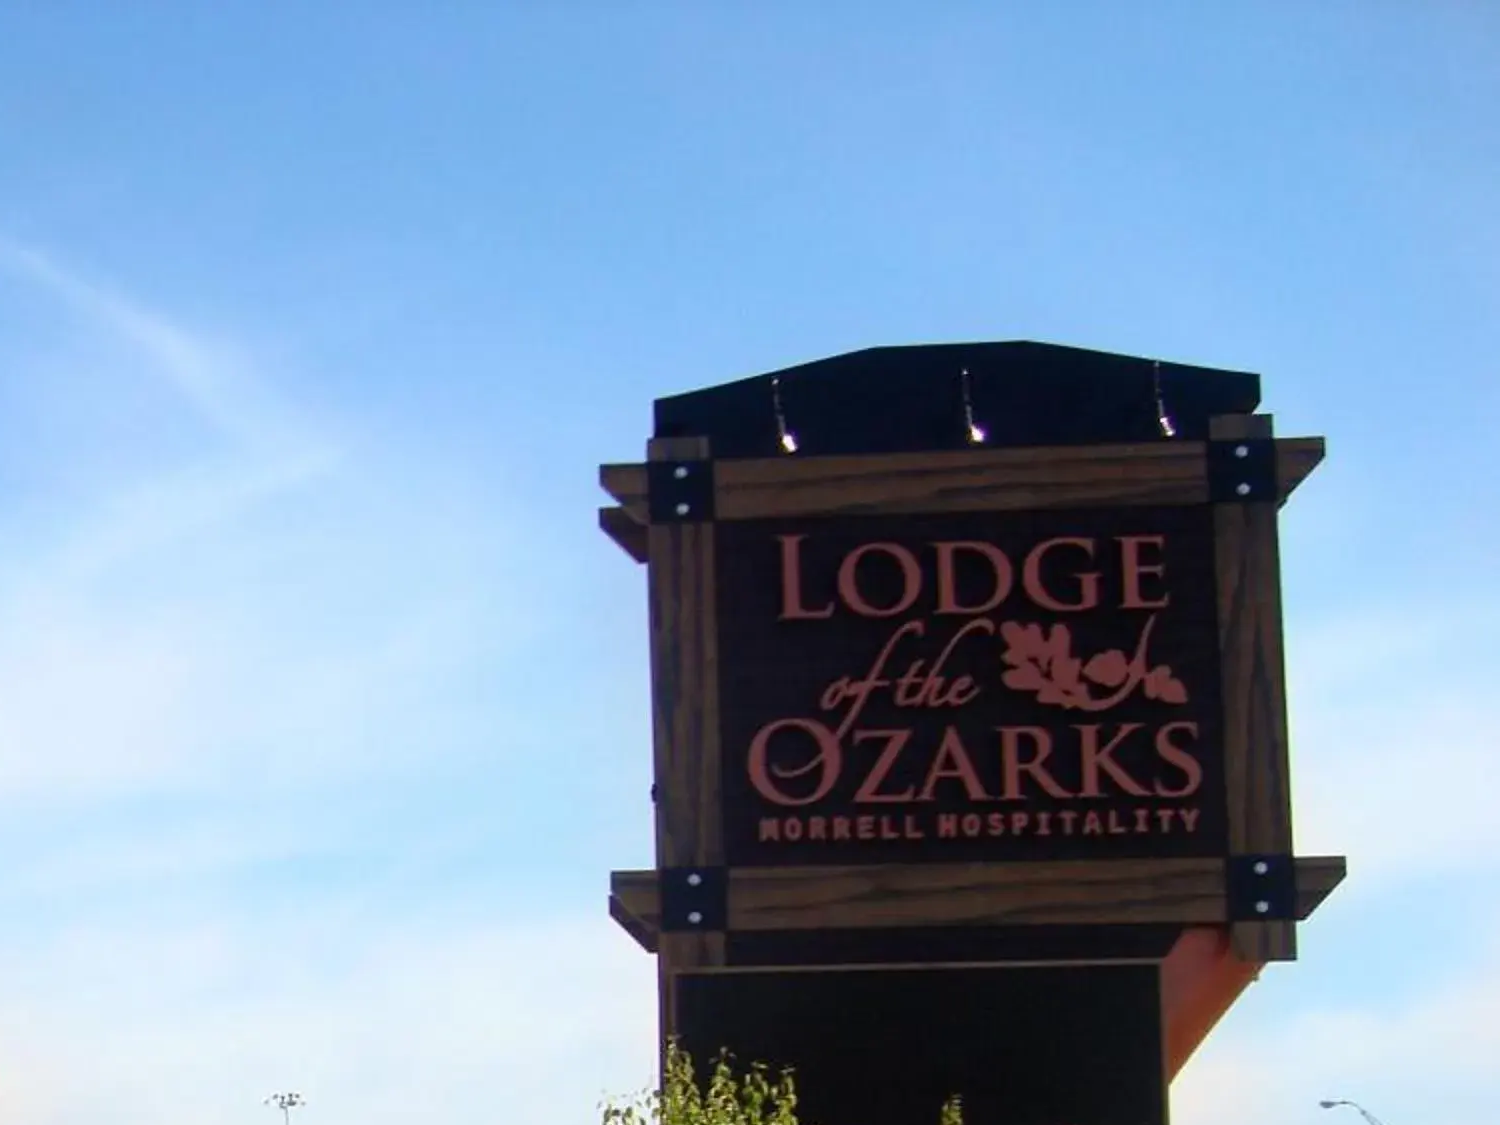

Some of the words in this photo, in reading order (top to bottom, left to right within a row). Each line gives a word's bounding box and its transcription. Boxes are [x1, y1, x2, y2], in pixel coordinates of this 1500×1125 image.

[778, 532, 1170, 621] LODGE
[795, 620, 923, 762] of
[893, 617, 994, 708] the
[746, 717, 1204, 807] OZARKS
[758, 813, 926, 842] MORRELL
[938, 808, 1201, 837] HOSPITALITY
